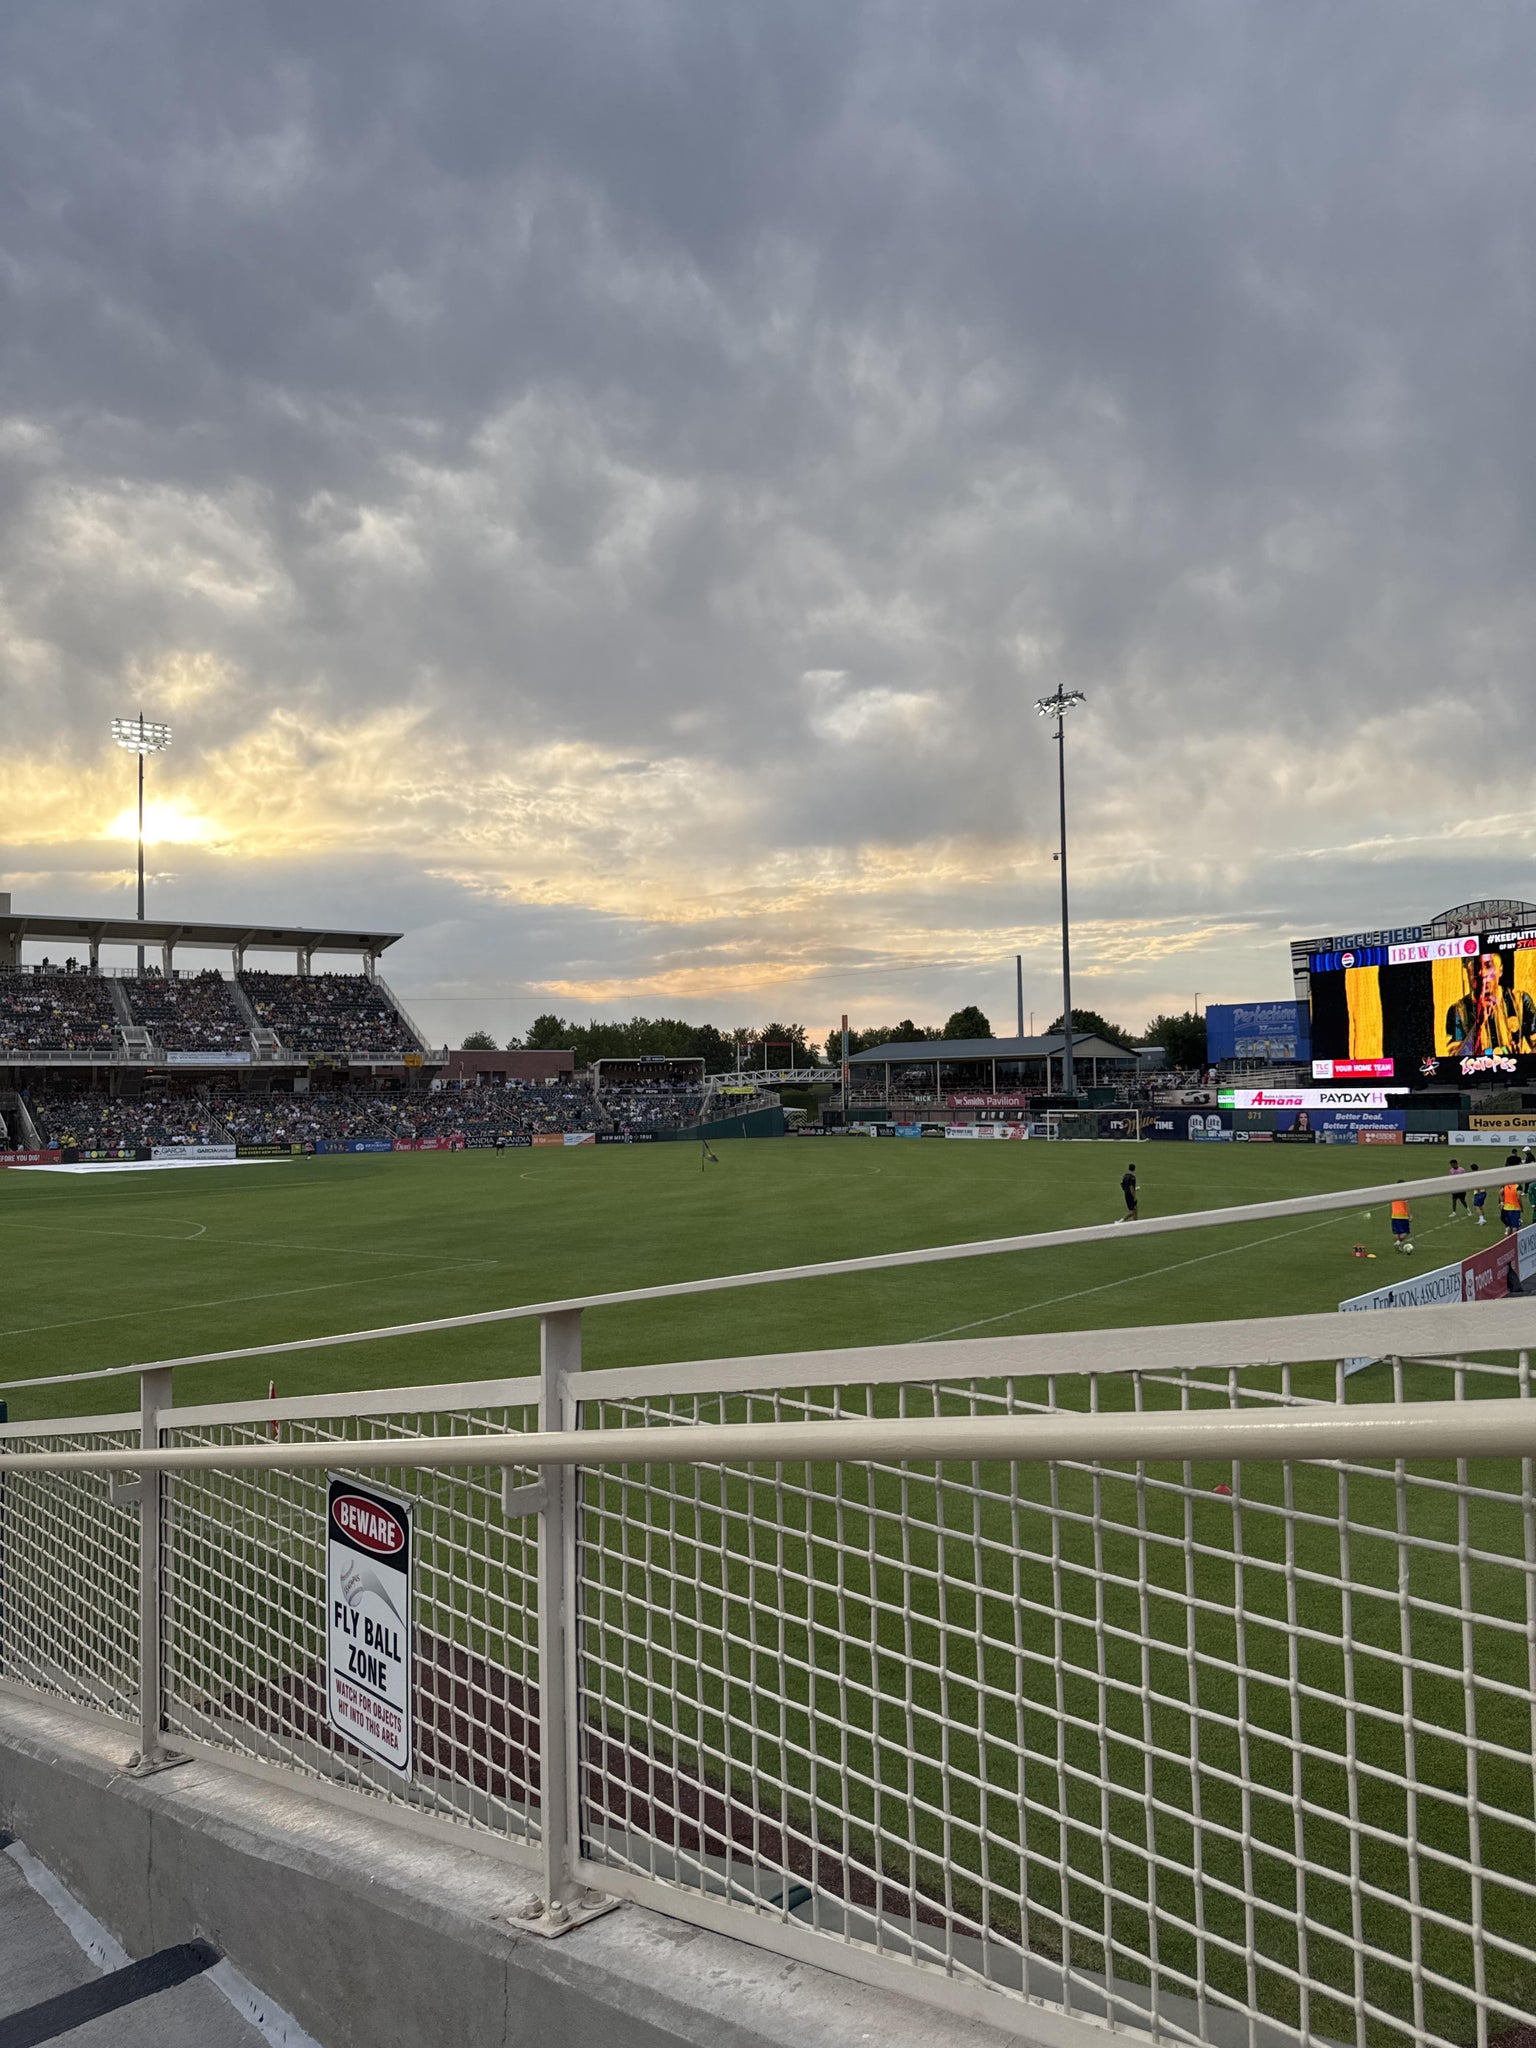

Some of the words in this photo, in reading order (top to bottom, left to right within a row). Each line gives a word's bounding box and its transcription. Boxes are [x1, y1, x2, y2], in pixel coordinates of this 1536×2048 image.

[1335, 932, 1373, 949] RGCU
[1380, 926, 1423, 944] FIELD
[1392, 945, 1429, 961] IBEW
[1438, 942, 1461, 956] 611
[1373, 1063, 1391, 1071] TEAM
[963, 1096, 985, 1105] Smith's
[987, 1096, 1020, 1105] Pavilion
[1250, 1091, 1303, 1105] Amana
[1320, 1093, 1370, 1103] PAYDAY
[1247, 1111, 1261, 1119] 371
[1474, 1118, 1501, 1127] Have
[1155, 1121, 1174, 1130] TIME
[1421, 1272, 1460, 1305] ASSOCIATES
[1475, 1268, 1493, 1290] TOYOTA
[340, 1501, 396, 1548] BEWARE
[334, 1600, 360, 1638] FLY
[364, 1616, 402, 1663] BALL
[348, 1643, 387, 1692] ZONE
[335, 1678, 358, 1702] WATCH
[359, 1695, 371, 1714] FOR
[373, 1702, 402, 1733] OBJECTS
[338, 1698, 348, 1718] HIT
[350, 1705, 364, 1728] INTO
[365, 1716, 380, 1738] THIS
[381, 1726, 399, 1751] AREA
